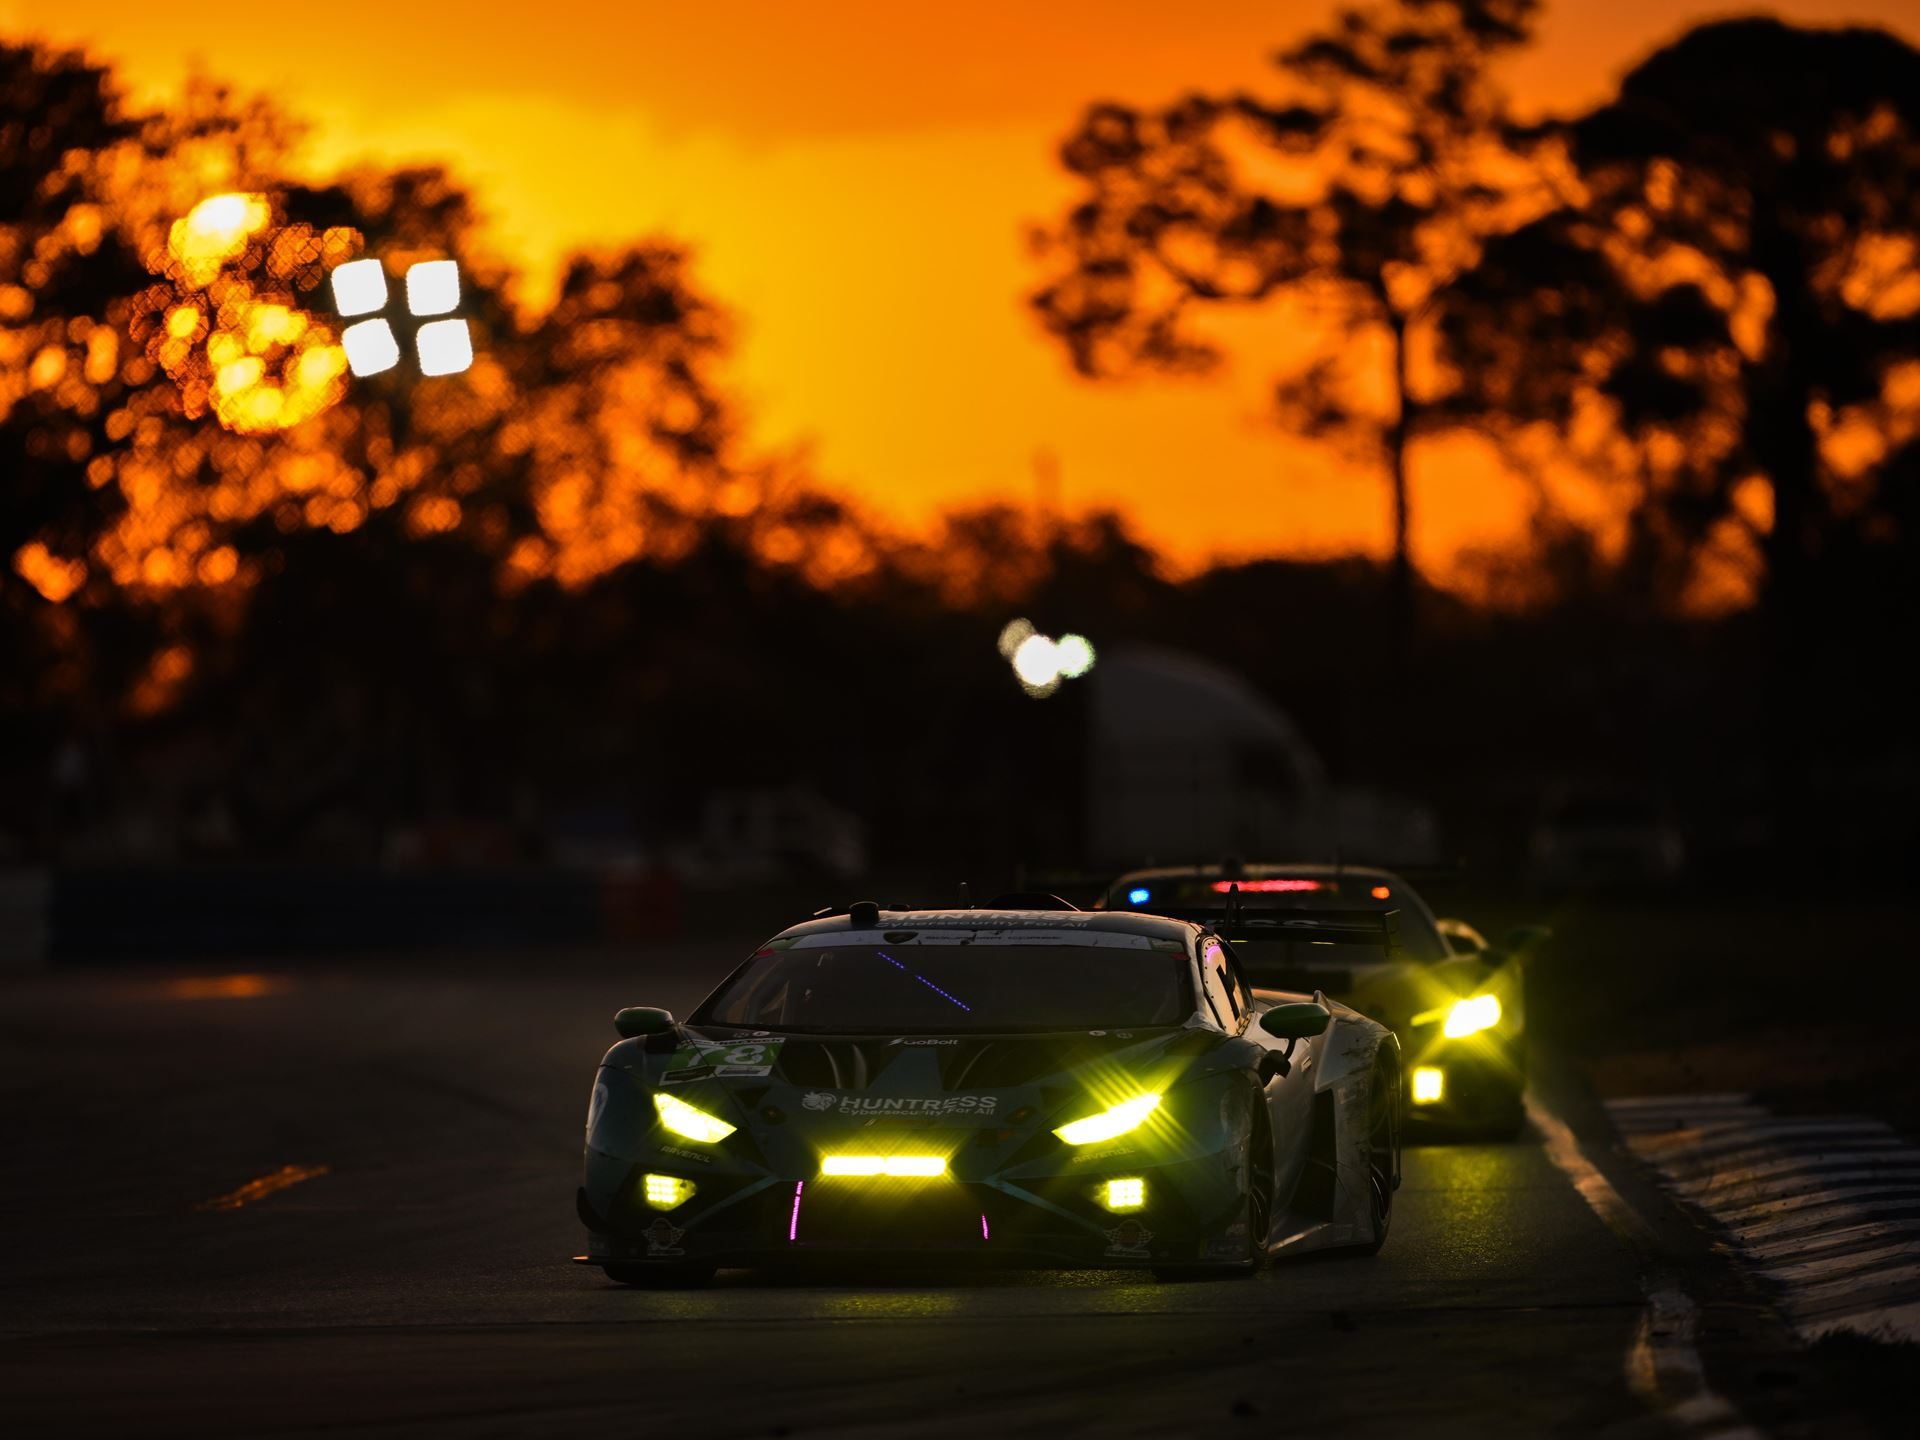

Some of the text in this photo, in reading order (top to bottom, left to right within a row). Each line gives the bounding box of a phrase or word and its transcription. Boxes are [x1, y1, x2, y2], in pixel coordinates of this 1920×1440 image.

[682, 1044, 766, 1067] 78
[840, 1095, 998, 1110] HUNTRESS
[839, 1107, 944, 1116] Cybersecurity
[973, 1107, 995, 1115] All
